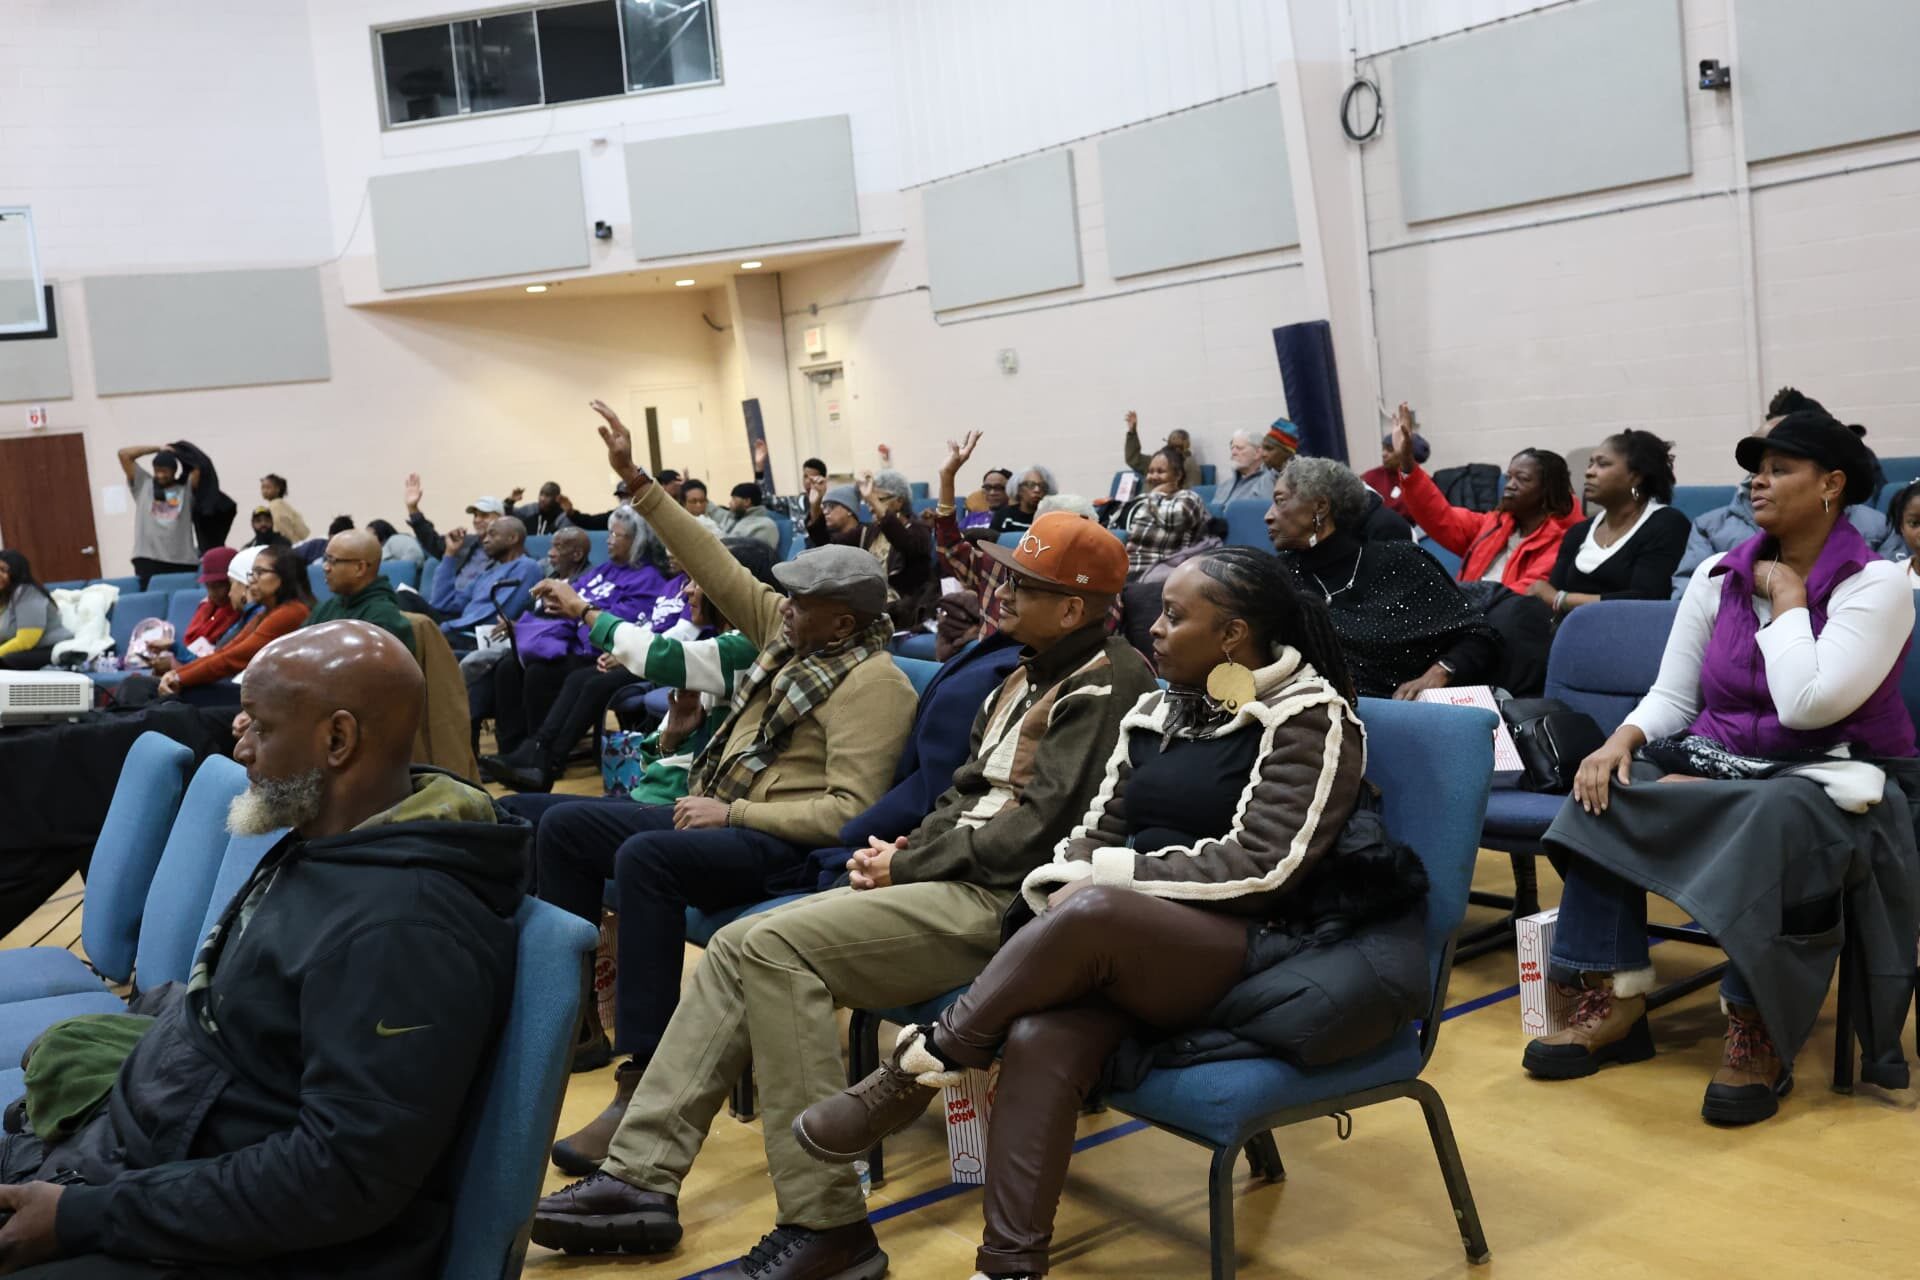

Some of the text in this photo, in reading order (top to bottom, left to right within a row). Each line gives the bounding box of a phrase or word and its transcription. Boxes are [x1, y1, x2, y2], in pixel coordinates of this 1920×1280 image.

[1521, 962, 1537, 972] POP
[1521, 972, 1542, 982] CORN
[948, 1098, 970, 1111] POP
[948, 1109, 976, 1125] CORN
